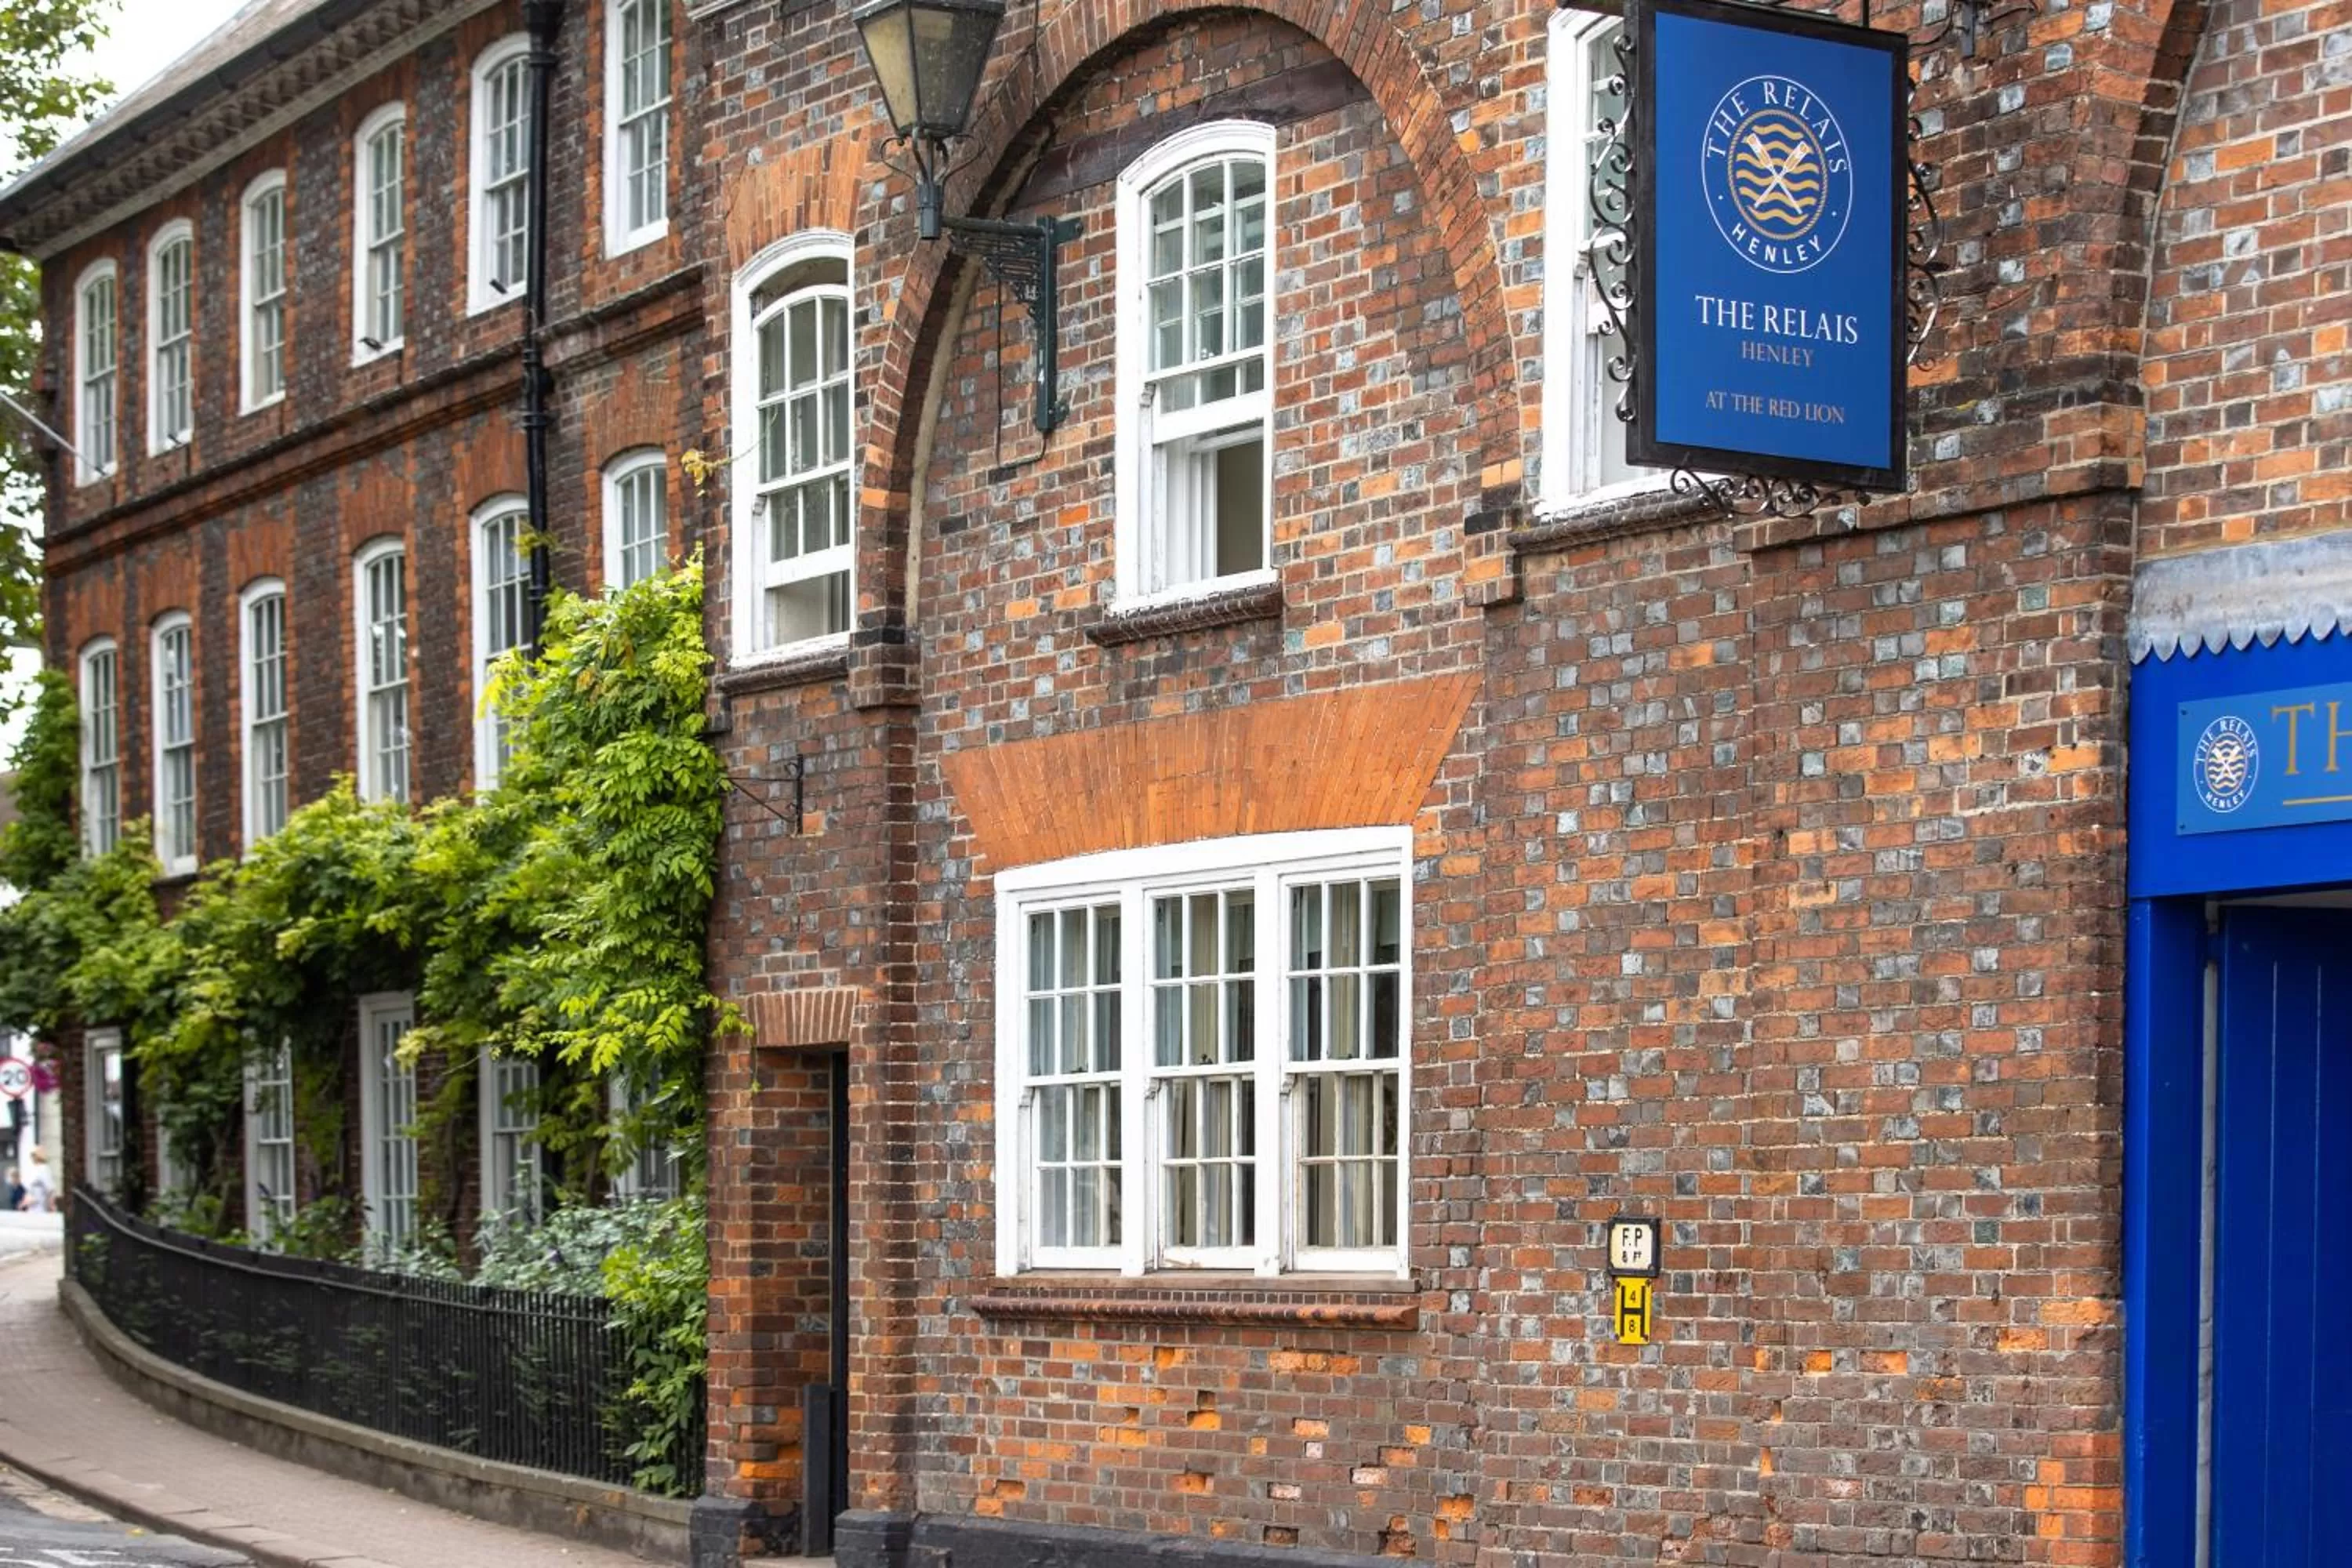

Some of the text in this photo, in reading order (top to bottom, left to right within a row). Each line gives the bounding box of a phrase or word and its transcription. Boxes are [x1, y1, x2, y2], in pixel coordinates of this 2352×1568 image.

[1707, 81, 1847, 173] THE RELAIS
[1732, 223, 1823, 264] HENLEY
[1695, 295, 1858, 344] THE RELAIS
[1741, 340, 1814, 368] HENLEY
[1705, 390, 1845, 424] AT THE RED LION
[3, 1069, 28, 1086] 20
[1629, 1290, 1637, 1303] 4
[1628, 1320, 1636, 1333] 8
